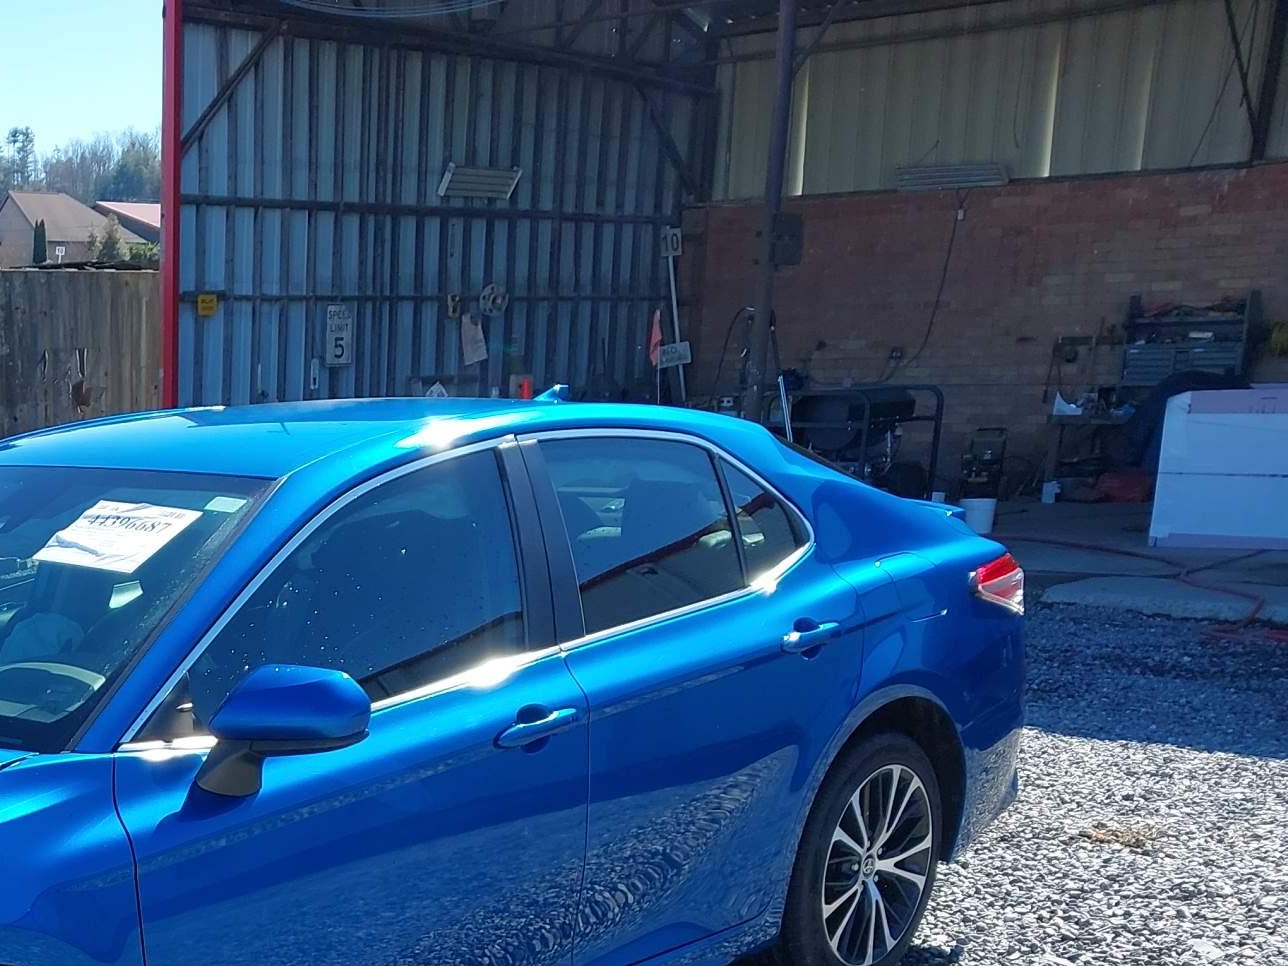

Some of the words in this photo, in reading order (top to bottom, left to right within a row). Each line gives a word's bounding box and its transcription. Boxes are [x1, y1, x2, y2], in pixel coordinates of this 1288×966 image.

[662, 233, 679, 252] 10
[329, 310, 351, 320] SPEED
[329, 323, 349, 332] LIMIT
[334, 336, 345, 359] 5
[88, 514, 172, 534] 44396687
